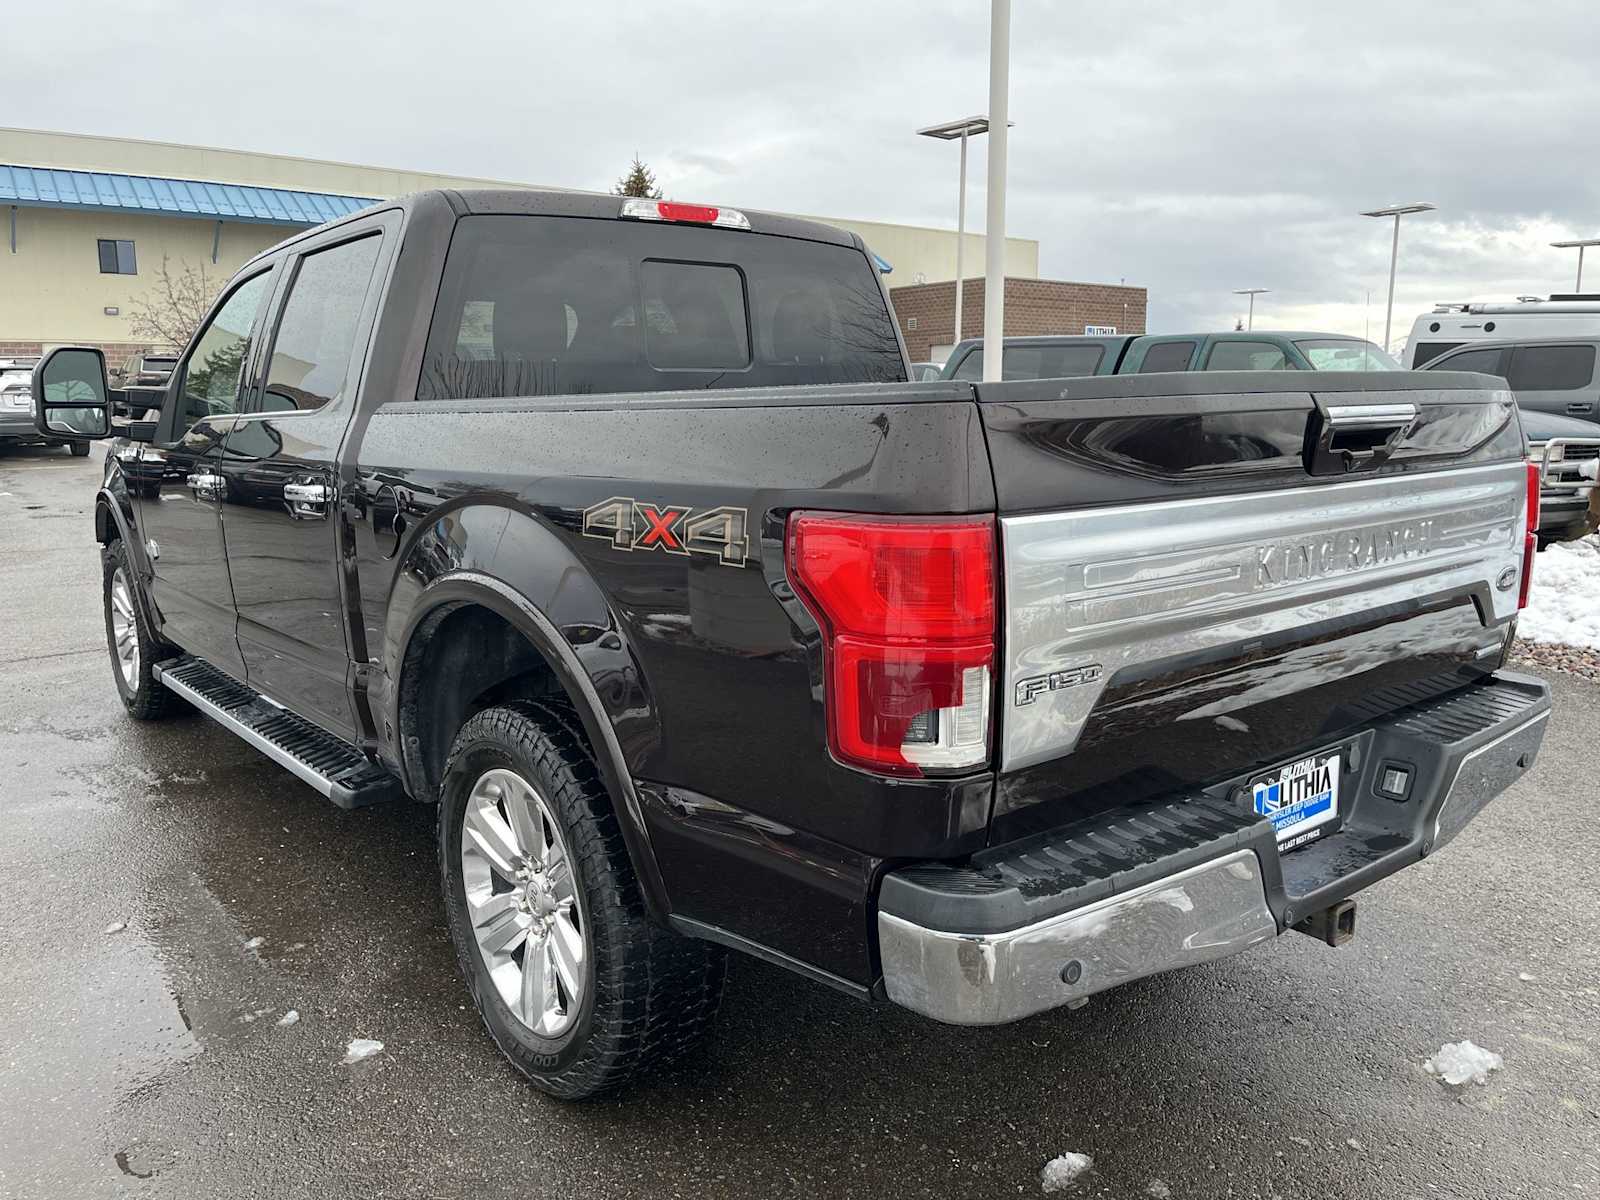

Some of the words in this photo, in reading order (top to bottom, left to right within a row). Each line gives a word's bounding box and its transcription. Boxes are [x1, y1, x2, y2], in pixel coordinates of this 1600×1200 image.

[1254, 539, 1334, 589] KING
[1346, 520, 1433, 572] RANCH
[1280, 766, 1332, 809] LITHIA
